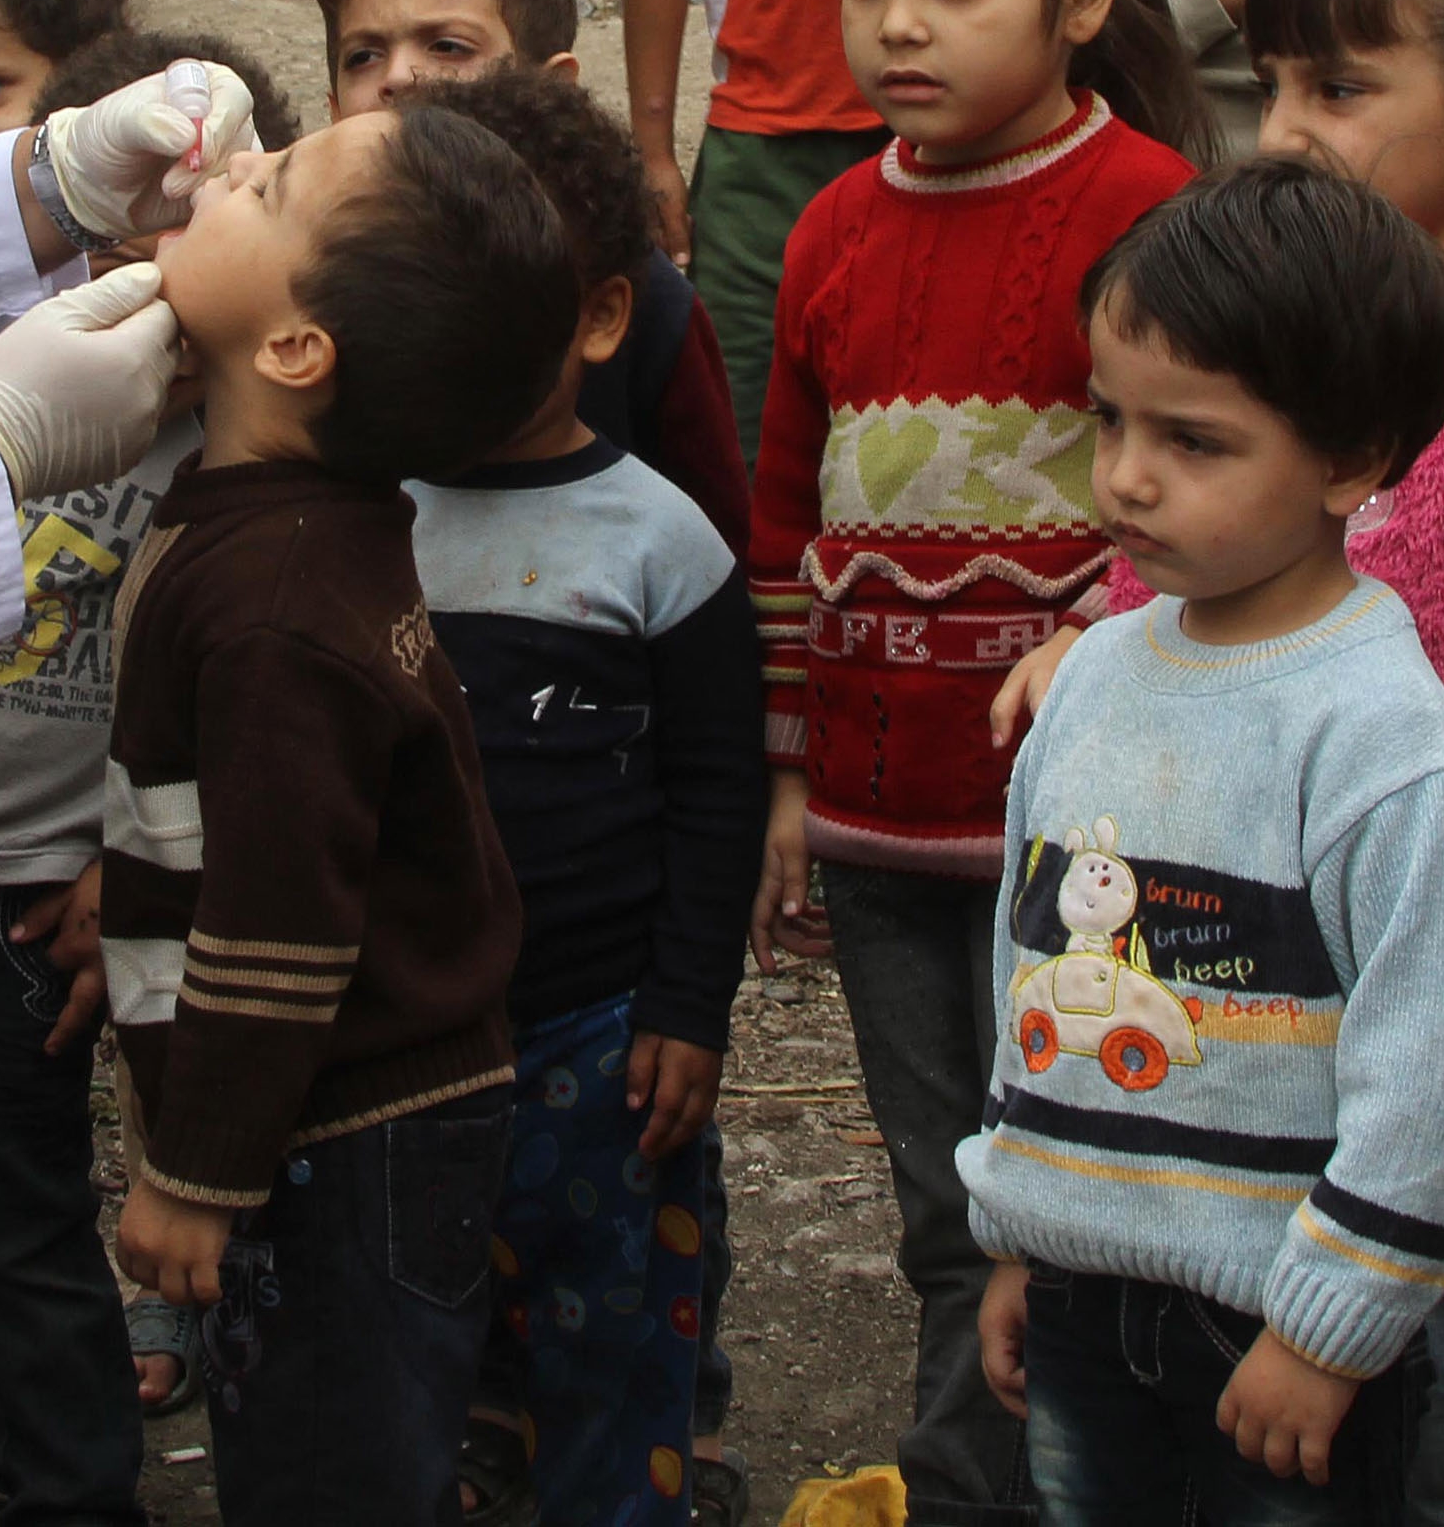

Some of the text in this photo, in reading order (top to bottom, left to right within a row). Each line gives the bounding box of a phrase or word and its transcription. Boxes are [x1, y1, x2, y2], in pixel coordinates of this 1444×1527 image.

[1145, 876, 1224, 914] brum
[1153, 922, 1232, 949] brum
[1174, 955, 1255, 985] beep
[1222, 993, 1306, 1029] beep
